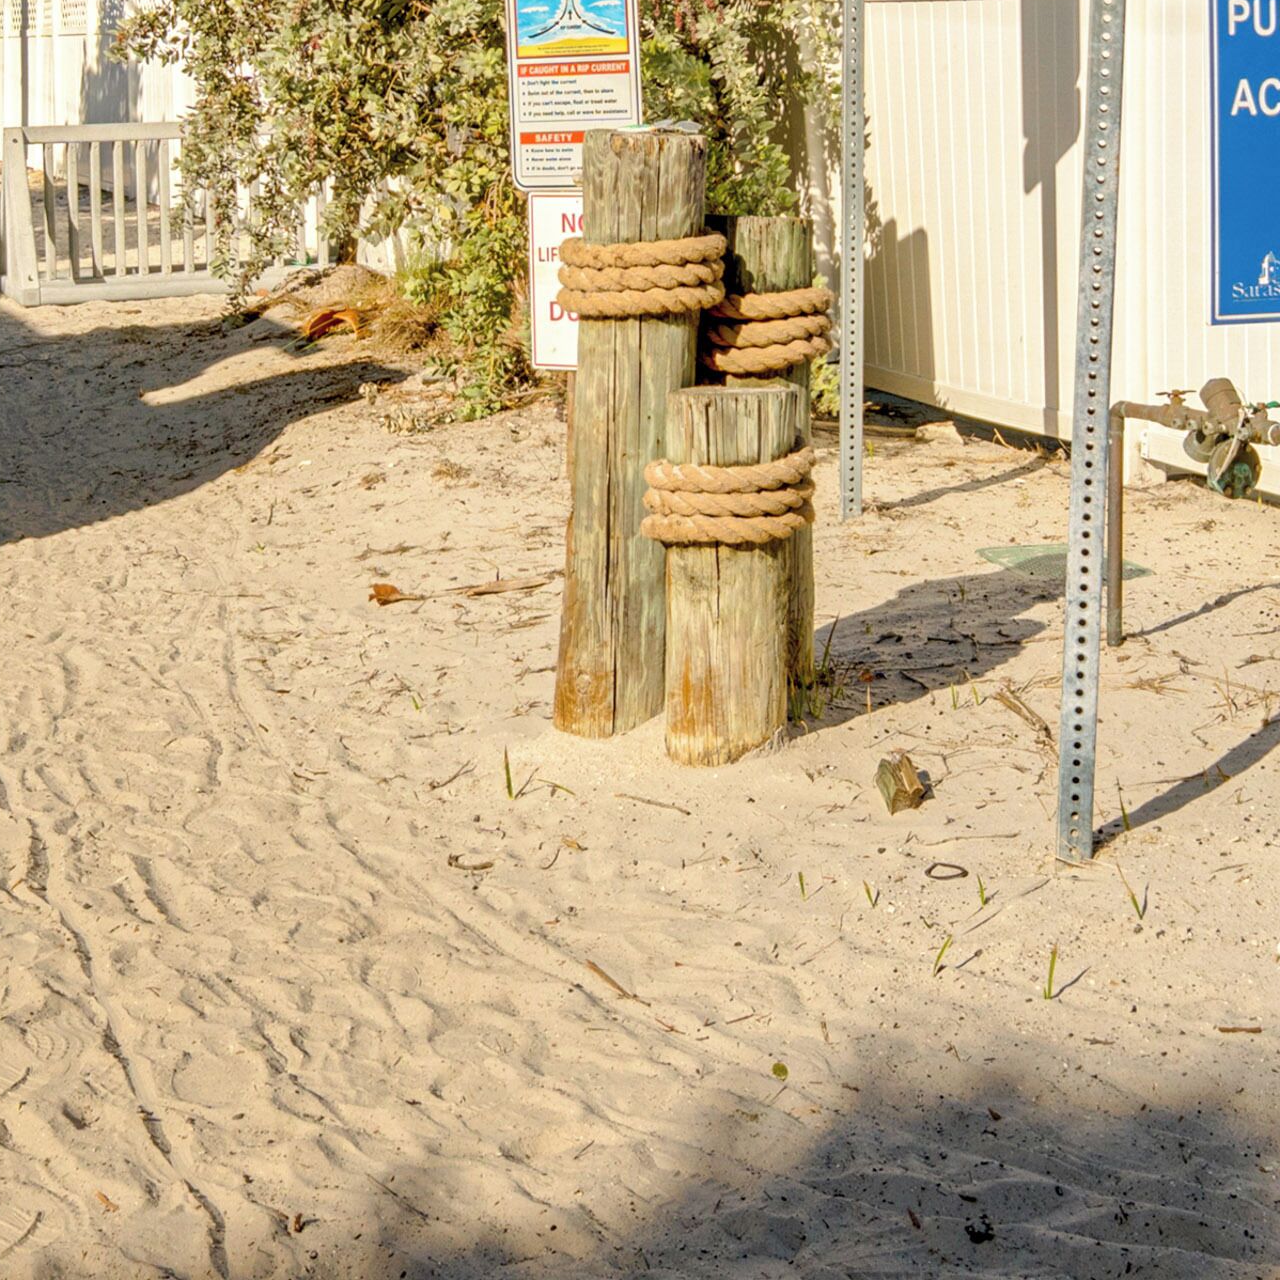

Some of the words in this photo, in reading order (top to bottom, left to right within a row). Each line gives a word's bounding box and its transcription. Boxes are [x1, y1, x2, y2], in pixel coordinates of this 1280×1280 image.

[520, 66, 527, 74] IF
[529, 65, 559, 74] CAUGHT
[560, 65, 569, 73] IN
[569, 64, 576, 73] A
[577, 64, 590, 72] RIP
[591, 62, 626, 72] CURRENT
[535, 133, 573, 142] SAFETY
